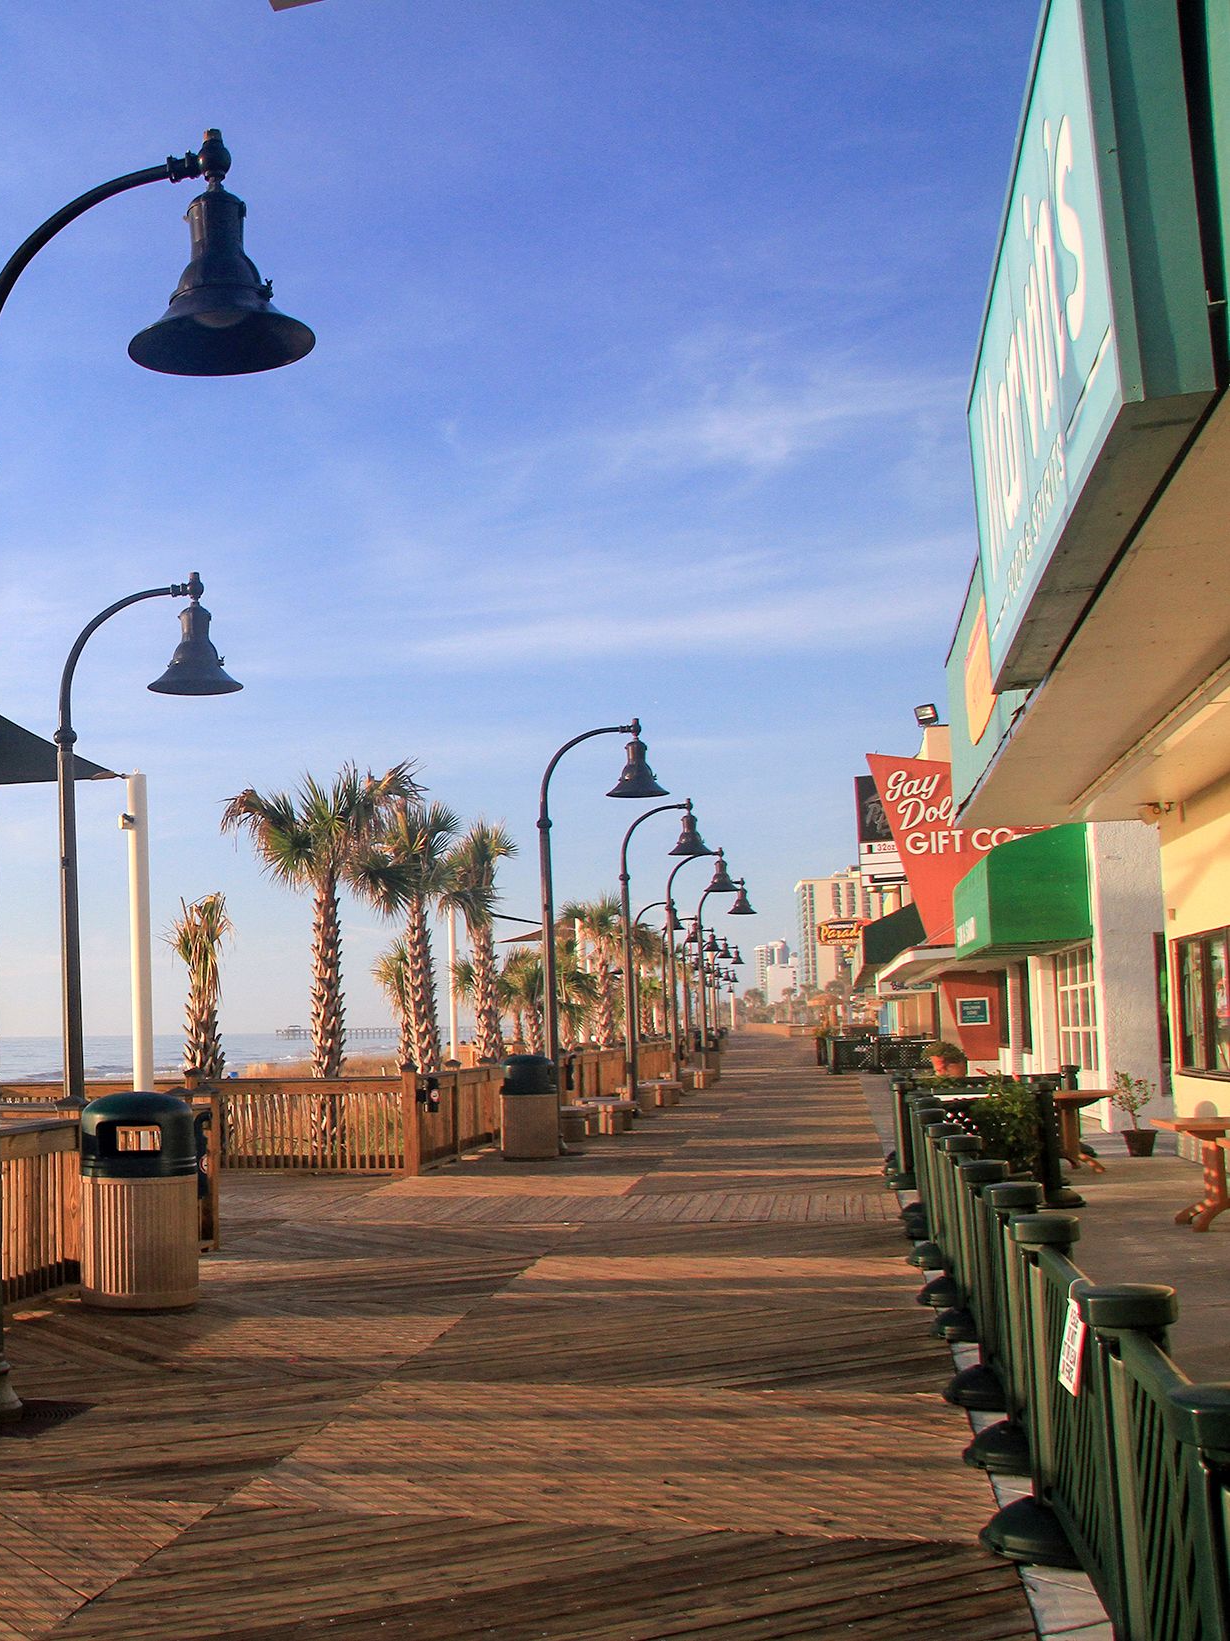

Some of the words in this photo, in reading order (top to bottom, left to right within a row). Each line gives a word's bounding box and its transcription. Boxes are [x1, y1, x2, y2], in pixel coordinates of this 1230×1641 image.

[980, 114, 1084, 583] Marvin's
[1031, 432, 1066, 544] SPIRITS
[885, 770, 940, 802] Gay
[905, 830, 964, 855] GIFT
